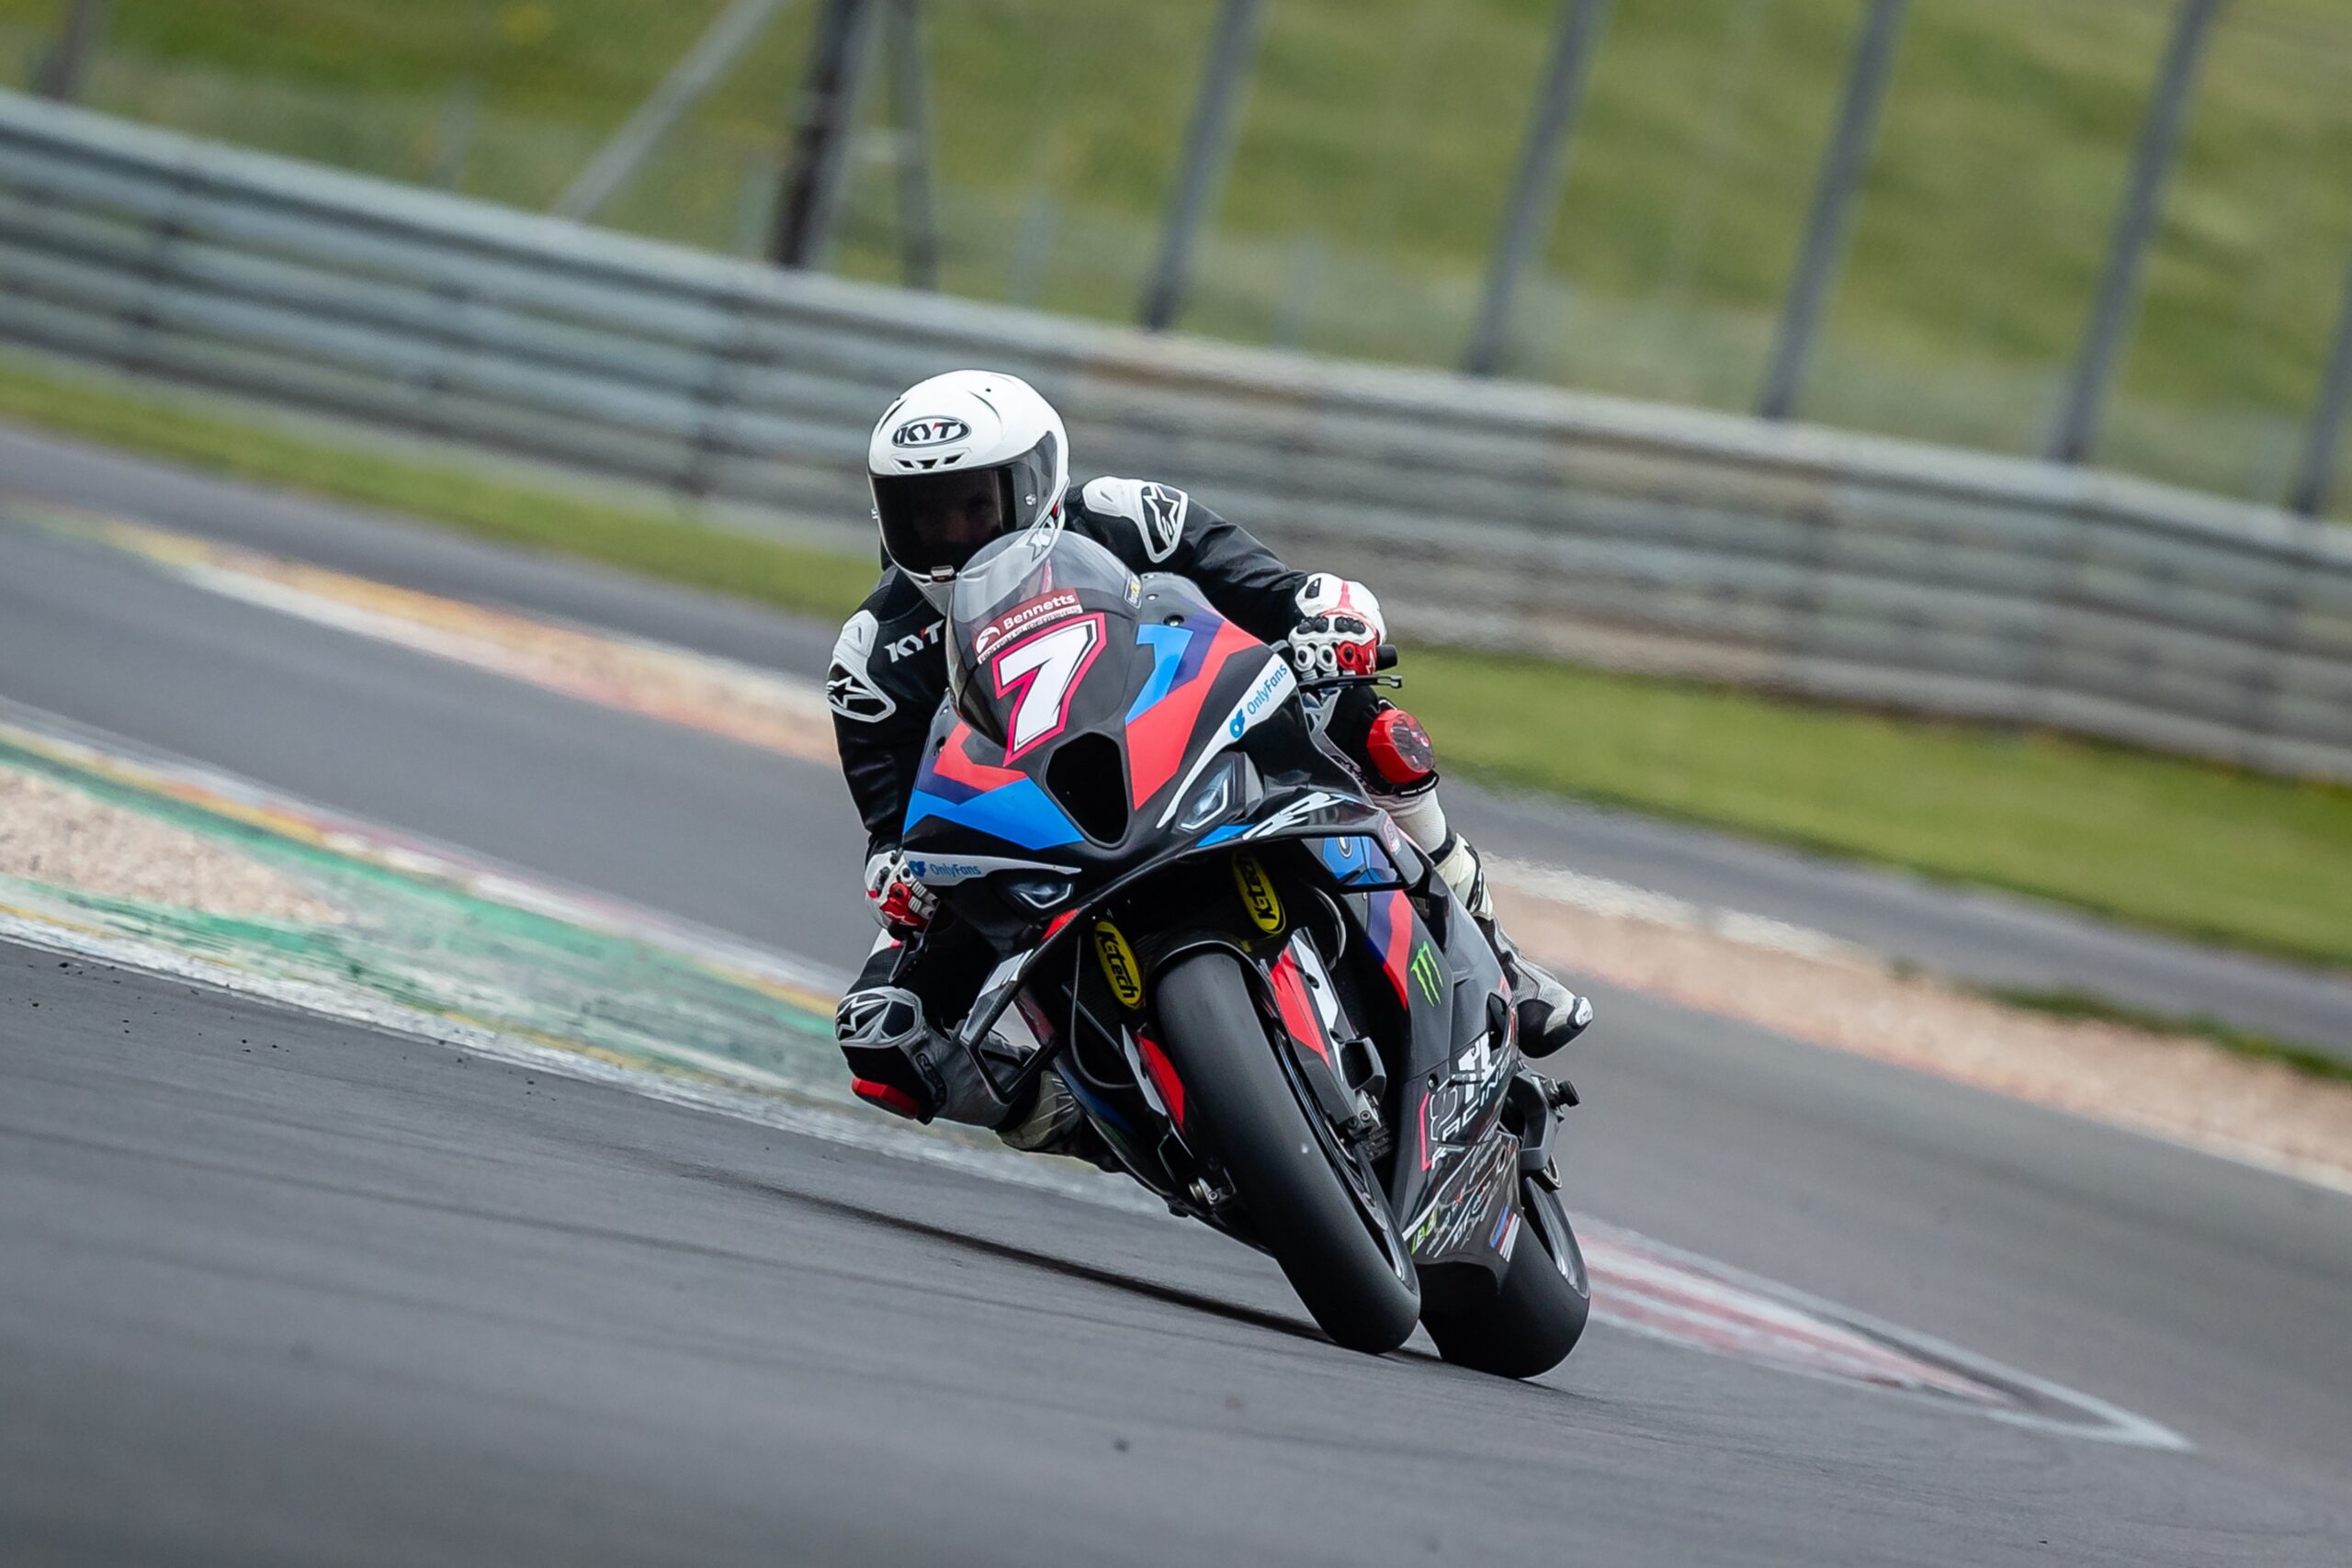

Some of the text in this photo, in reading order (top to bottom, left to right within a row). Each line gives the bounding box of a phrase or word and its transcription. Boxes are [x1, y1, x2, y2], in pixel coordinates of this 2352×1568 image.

[899, 422, 959, 446] KYT
[1002, 594, 1076, 630] Bennetts
[884, 619, 944, 663] KYT
[993, 615, 1104, 763] 7
[1247, 664, 1288, 715] OnlyFans
[929, 863, 981, 878] OnlyFans
